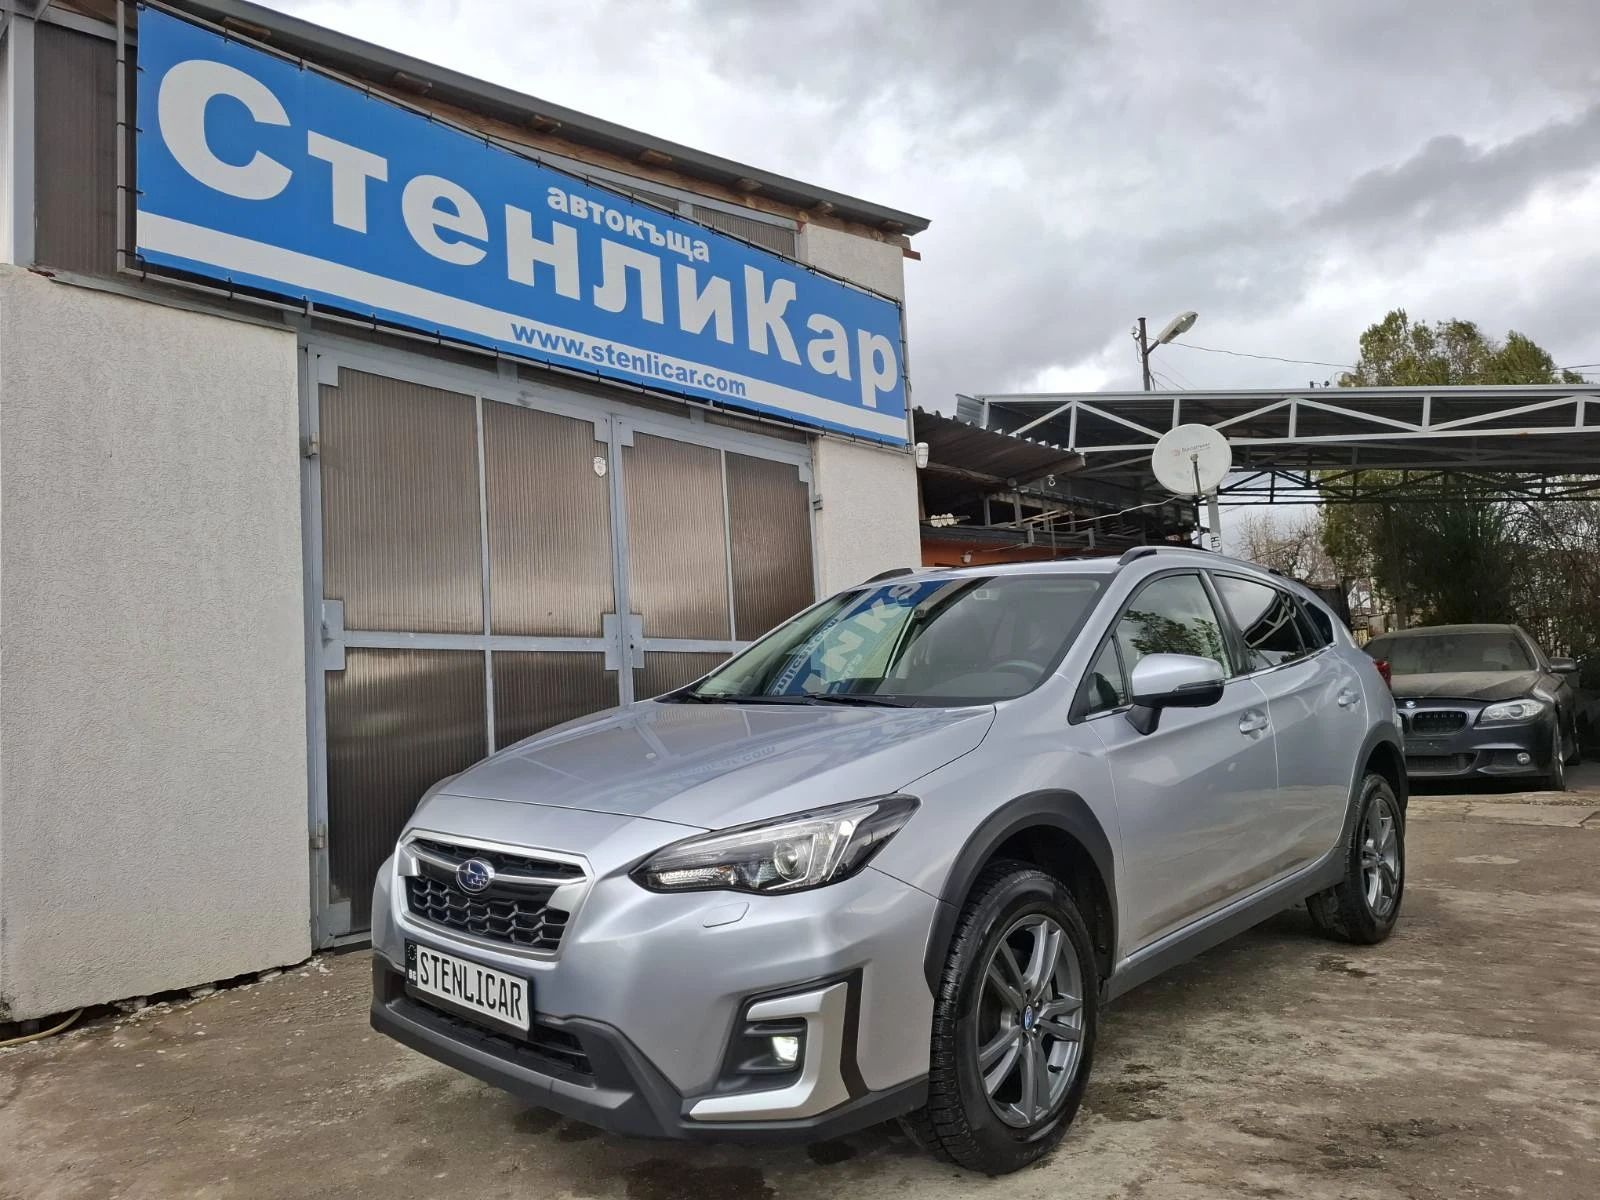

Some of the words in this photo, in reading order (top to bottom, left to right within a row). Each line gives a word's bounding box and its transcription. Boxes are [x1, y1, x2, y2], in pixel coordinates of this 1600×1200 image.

[158, 59, 898, 409] СтенлиКар
[547, 186, 709, 262] автокъща
[511, 322, 746, 396] www.stenlicar.com
[420, 951, 522, 1021] STENLICAR
